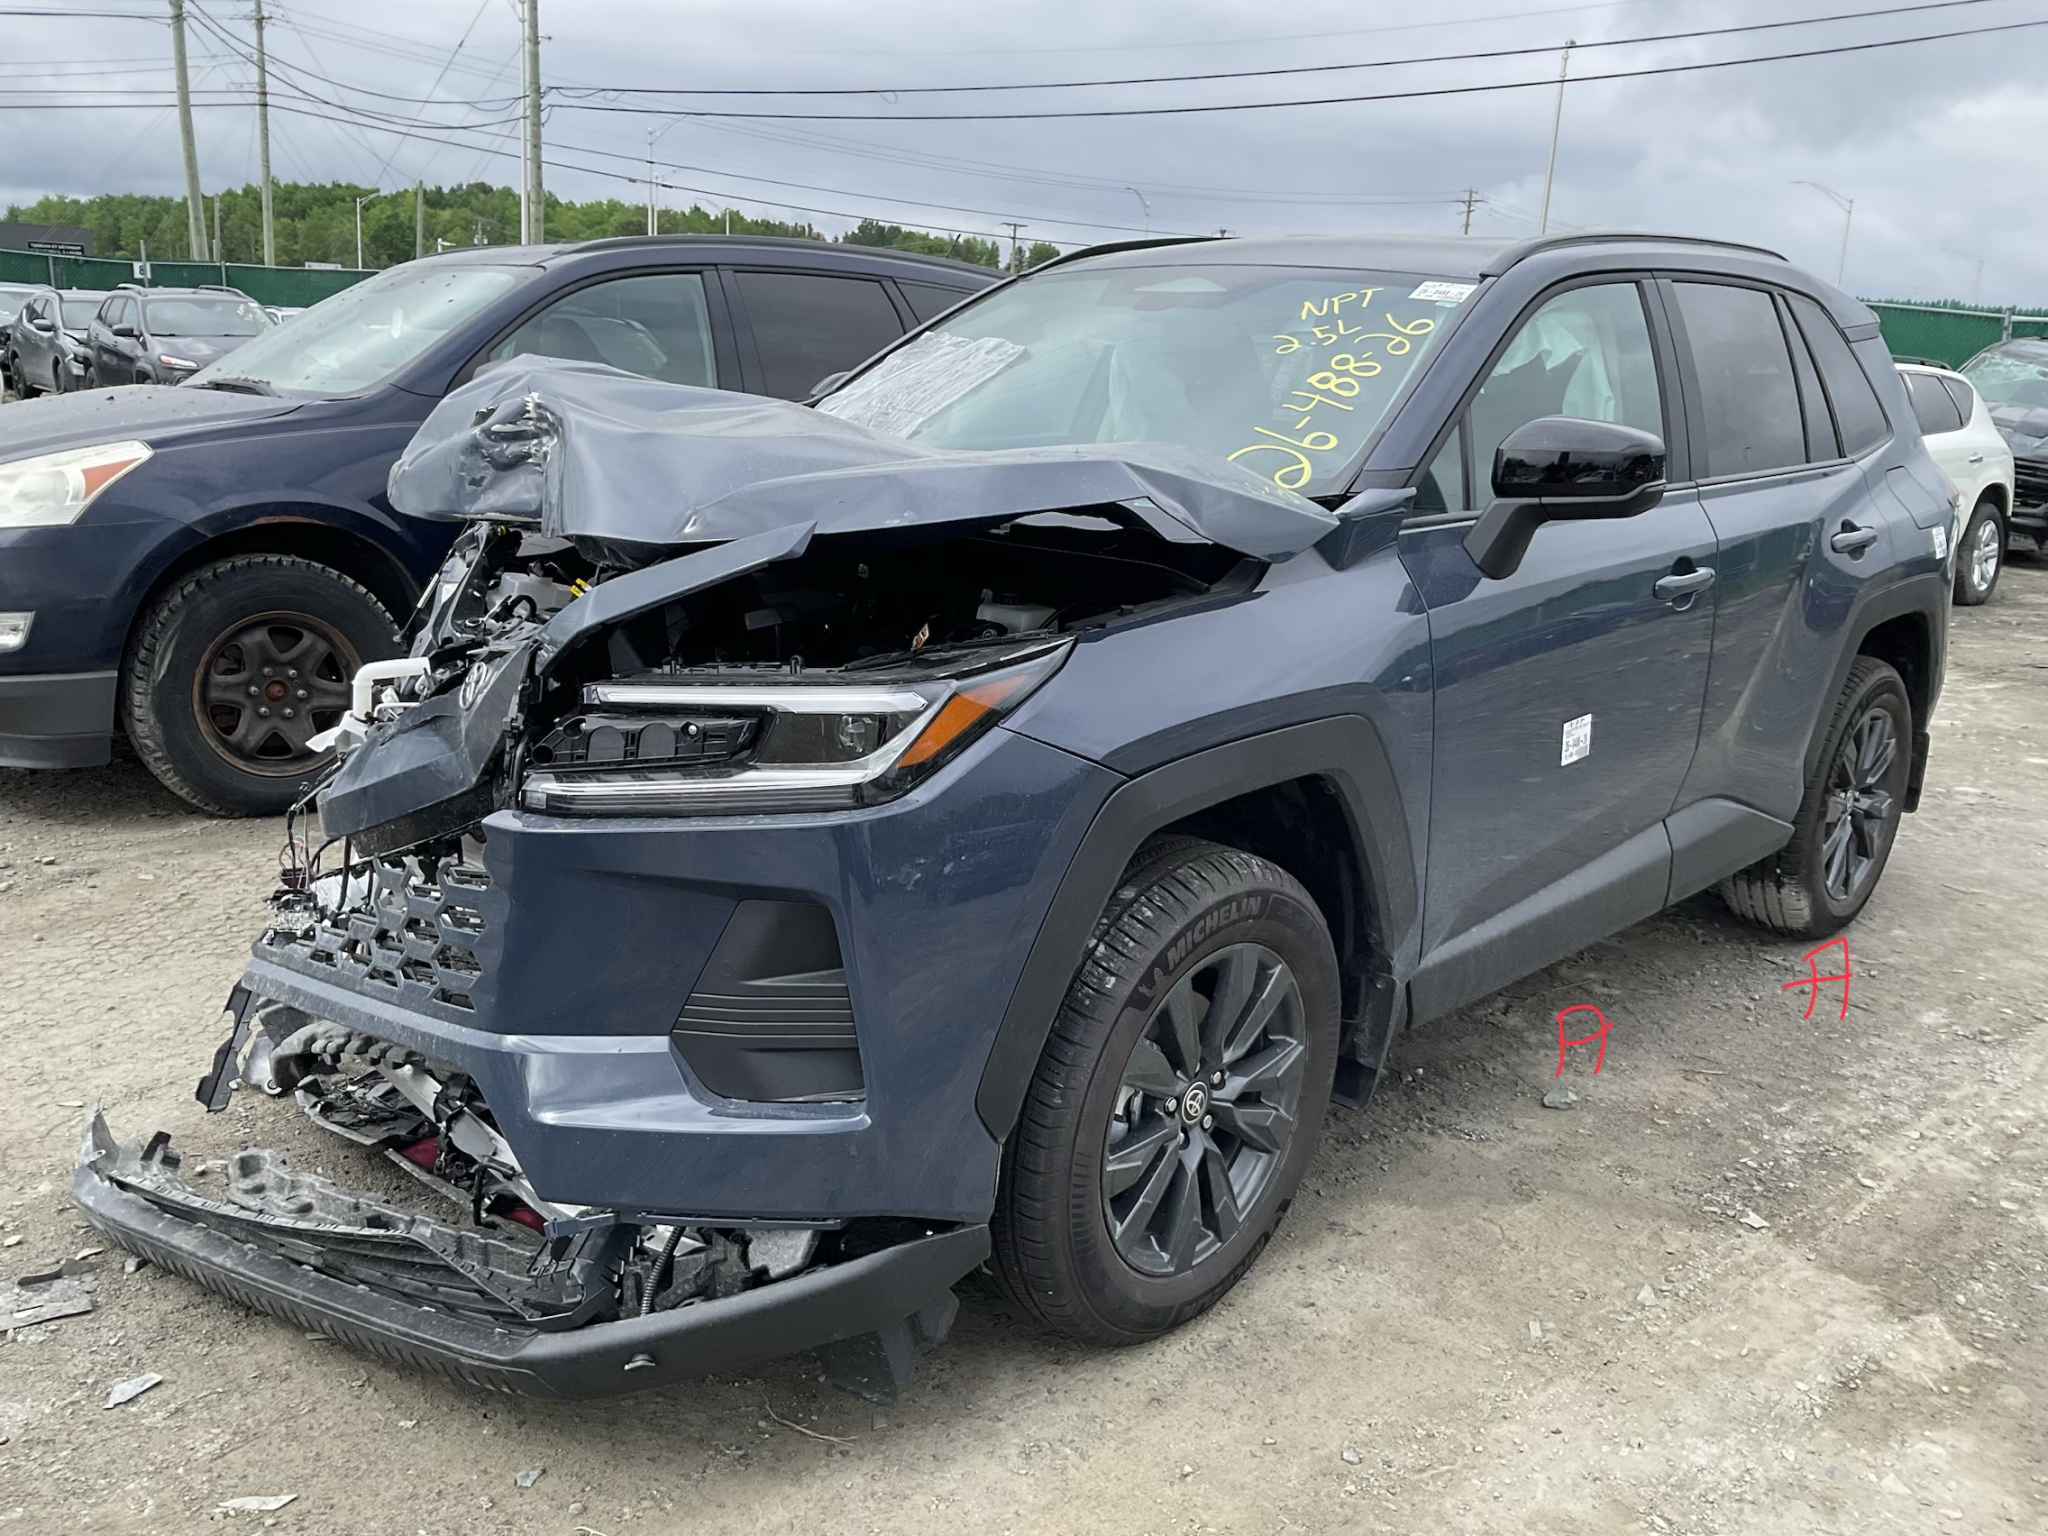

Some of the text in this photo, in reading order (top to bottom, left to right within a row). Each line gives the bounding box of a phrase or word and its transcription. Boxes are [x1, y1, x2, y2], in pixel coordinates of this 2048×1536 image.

[1301, 288, 1384, 320] NPT
[1272, 320, 1362, 354] 2.5L
[1167, 896, 1262, 971] MICHELIN
